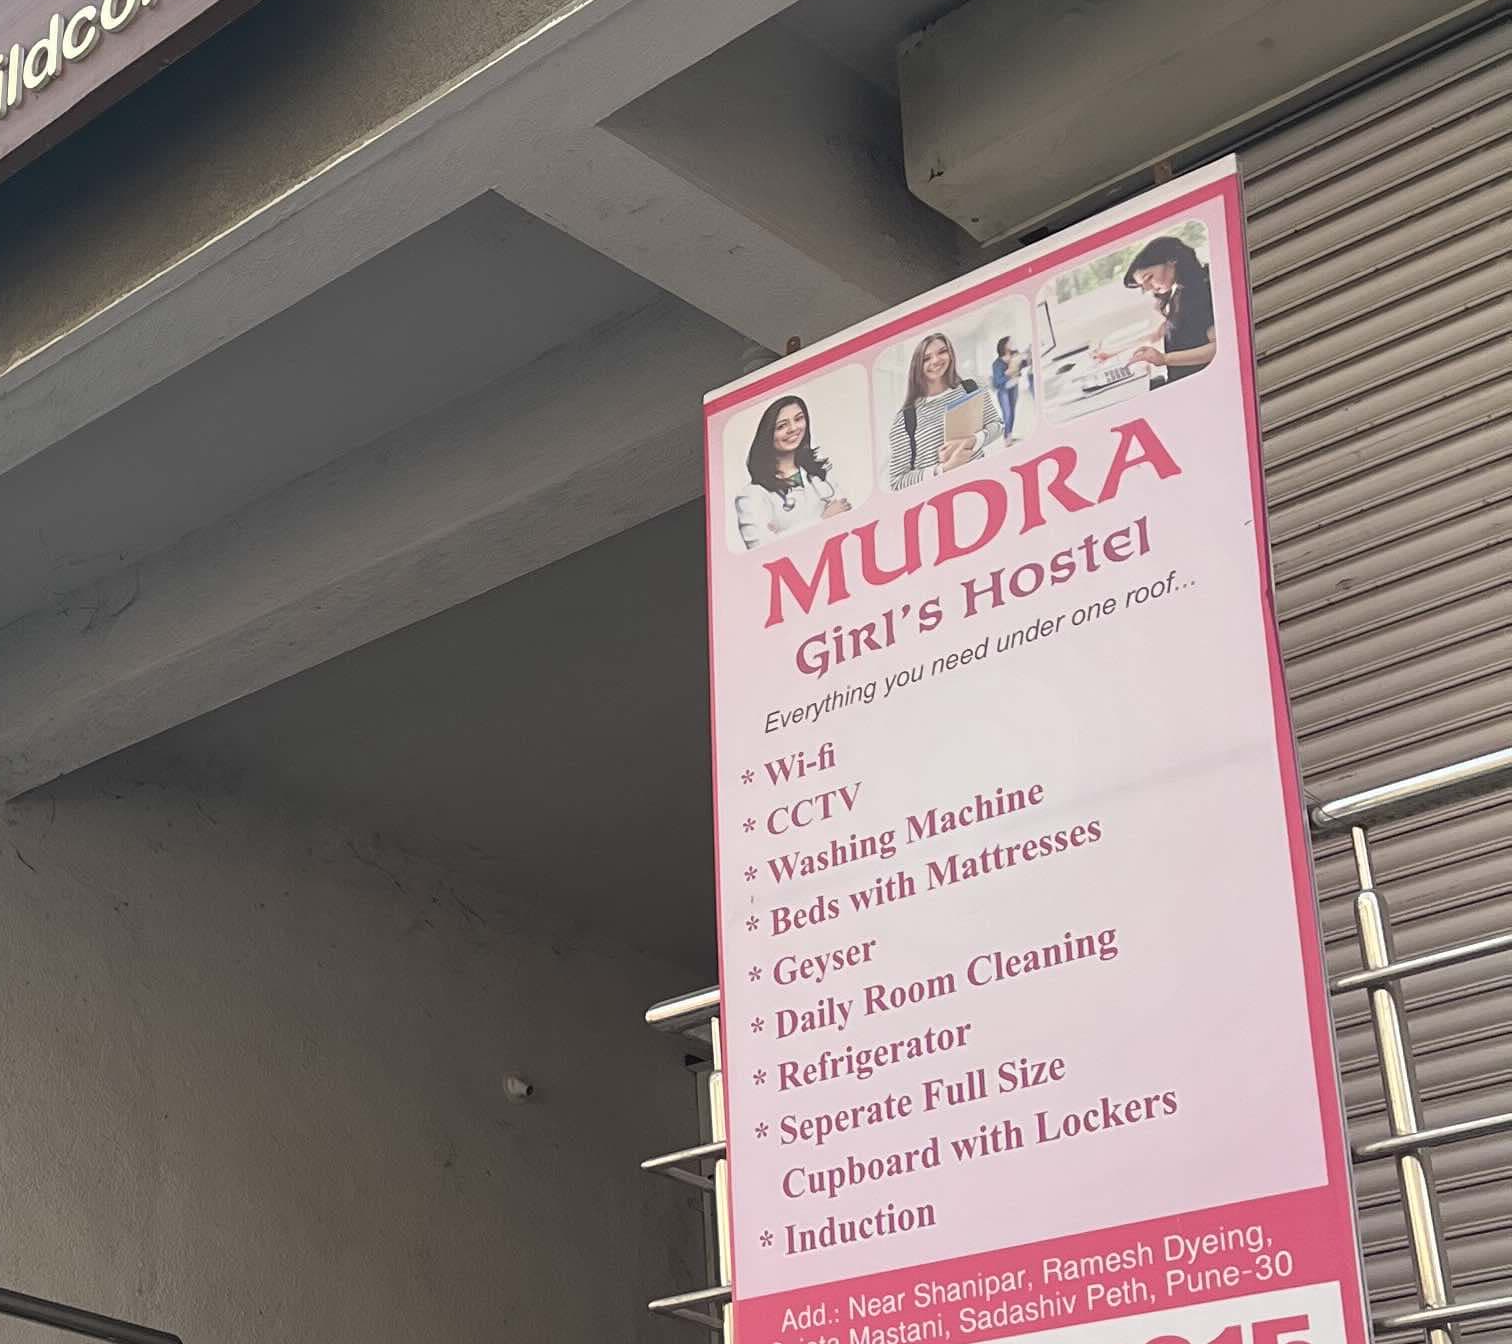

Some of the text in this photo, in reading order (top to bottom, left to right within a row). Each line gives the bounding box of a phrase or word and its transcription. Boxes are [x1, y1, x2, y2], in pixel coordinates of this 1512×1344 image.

[762, 417, 1182, 629] MUDRA
[961, 515, 1153, 619] Hostel
[764, 570, 1195, 734] Everything you need under one roof...
[764, 743, 838, 787] Wi-fi
[767, 782, 865, 837] CCTV
[768, 778, 1044, 885] Washing Machine
[770, 816, 1103, 938] Beds with Mattresses
[772, 935, 879, 992] Geyser
[775, 924, 1119, 1041] Daily Room Cleaning
[777, 1020, 973, 1094] Refrigerator
[779, 1055, 1067, 1152] Seperate Full Size
[782, 1086, 1179, 1203] Cupboard with Lockers
[785, 1198, 937, 1257] Induction
[848, 1289, 904, 1320] Near
[912, 1265, 1034, 1317] Shanipar,
[1042, 1243, 1155, 1286] Ramesh
[1163, 1222, 1274, 1272] Dyeing,
[958, 1292, 1077, 1337] Sadashiv
[1086, 1274, 1157, 1315] Peth,
[1166, 1249, 1293, 1297] Pune-30
